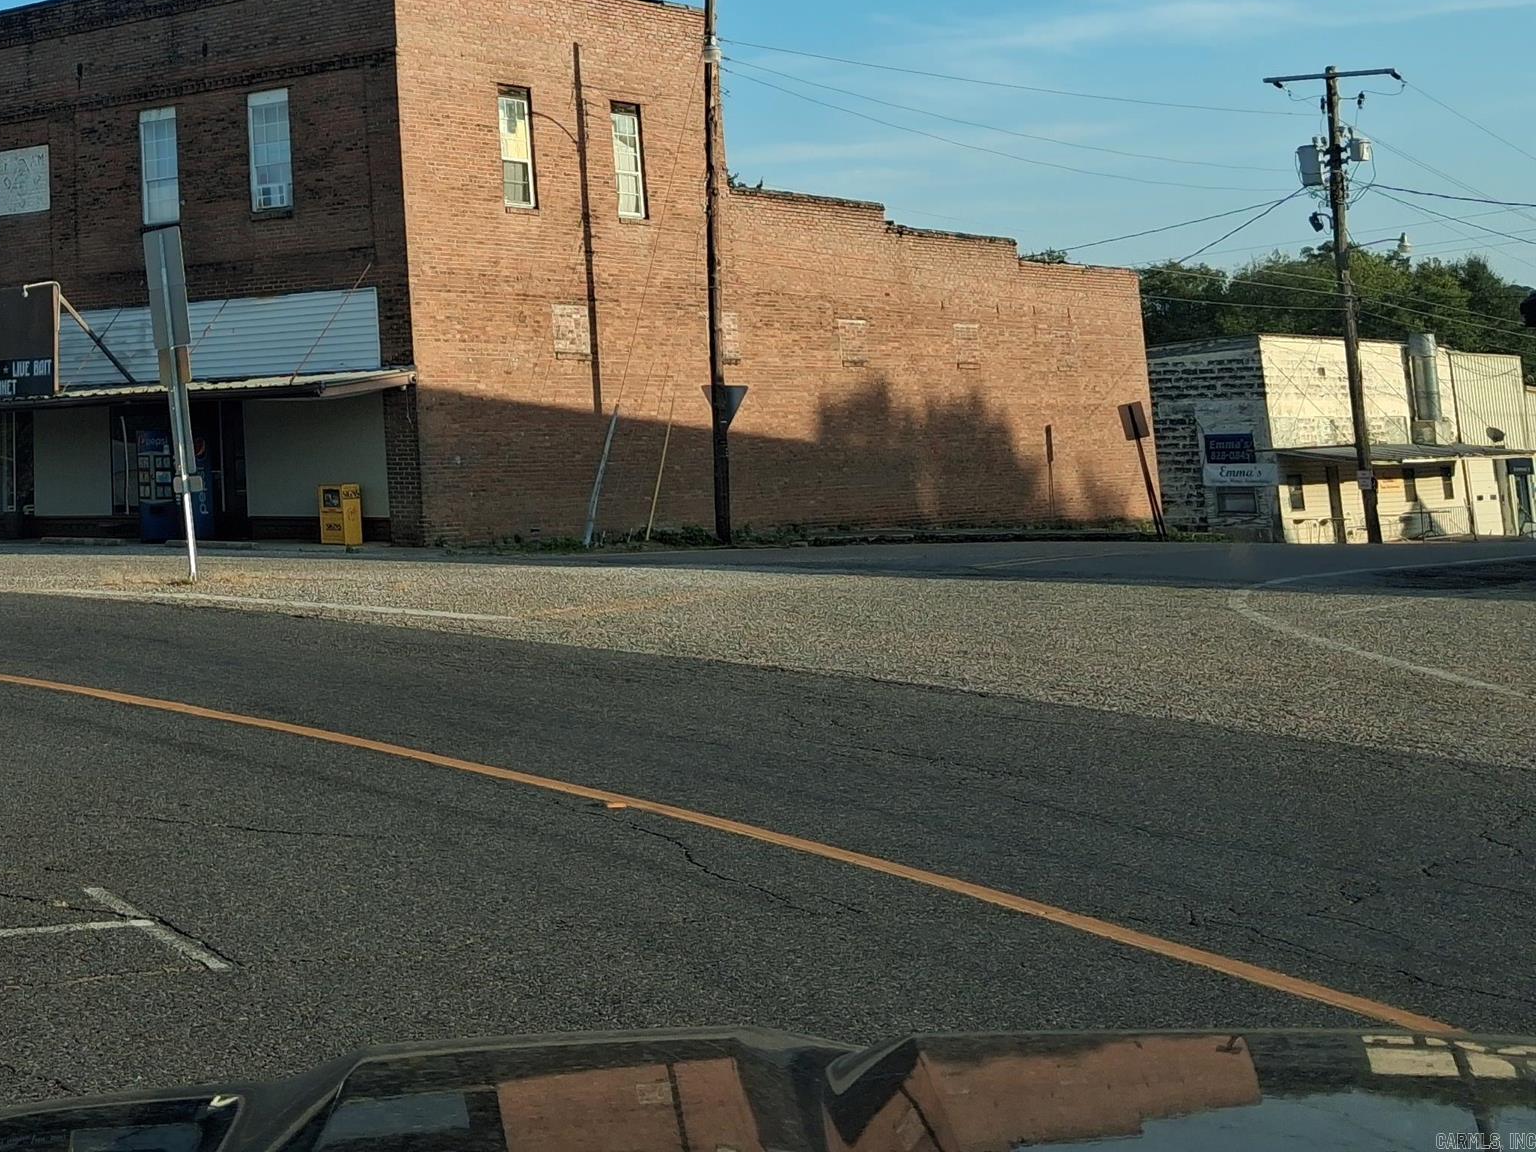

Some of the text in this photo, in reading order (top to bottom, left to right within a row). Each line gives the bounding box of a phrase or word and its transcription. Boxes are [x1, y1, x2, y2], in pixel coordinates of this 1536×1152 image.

[12, 361, 31, 377] LIVE
[33, 359, 52, 376] BAIT
[1219, 466, 1262, 478] Emma's
